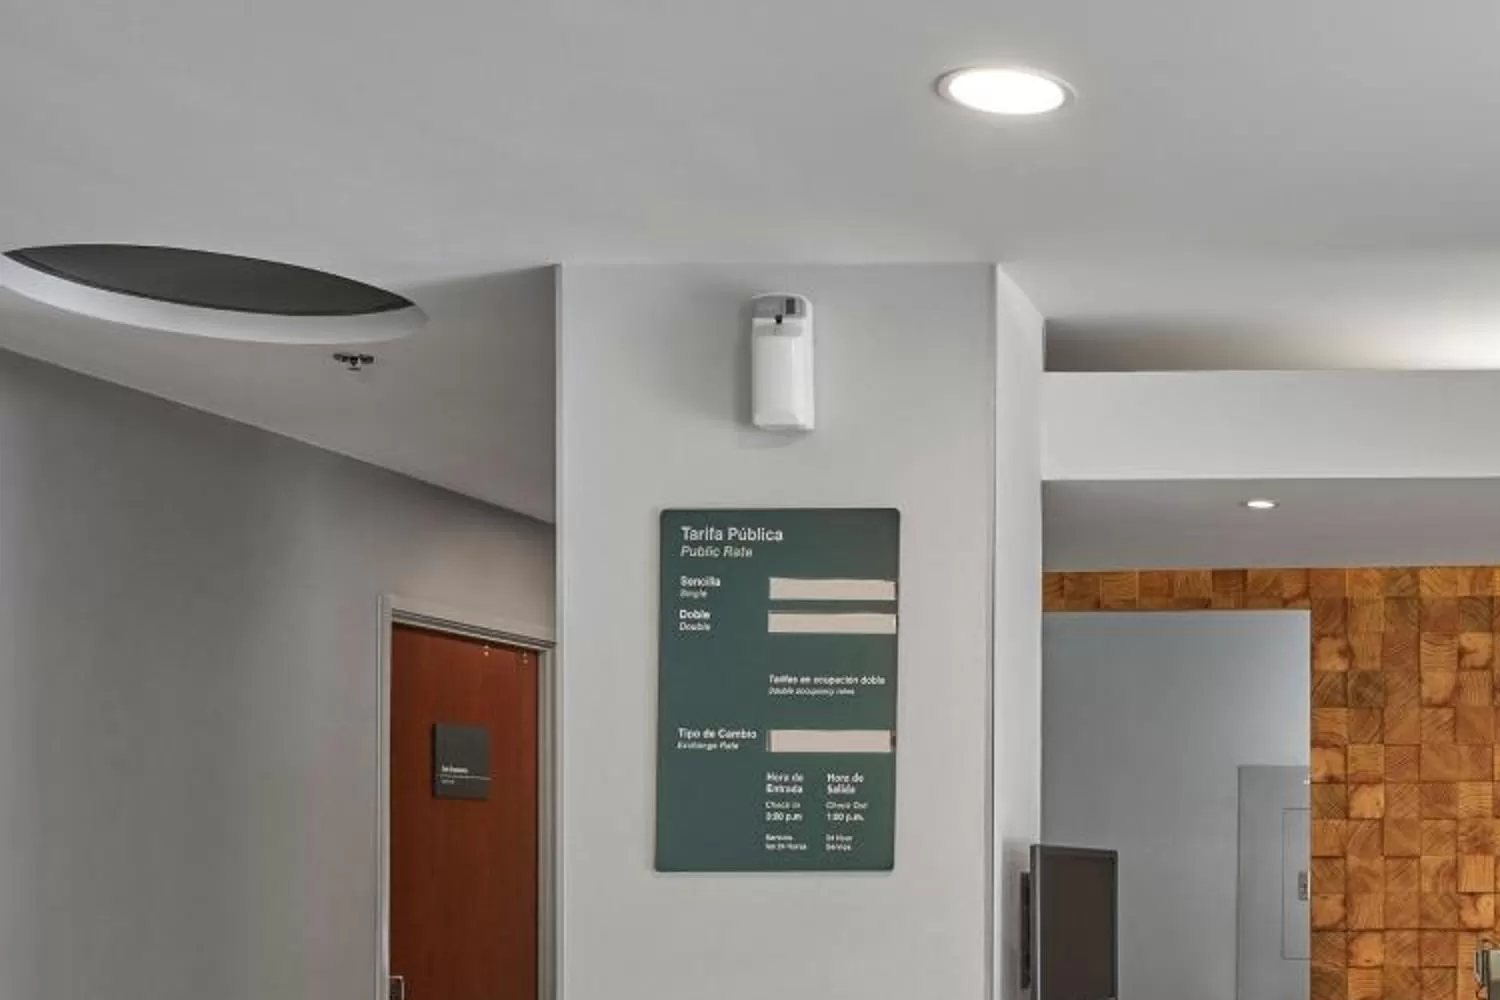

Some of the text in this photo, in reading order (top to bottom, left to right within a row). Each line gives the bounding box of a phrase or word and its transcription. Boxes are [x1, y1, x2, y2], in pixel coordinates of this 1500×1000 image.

[681, 526, 784, 541] Tarifa Pública
[680, 545, 753, 558] Public Rate
[679, 609, 711, 619] Doble
[679, 621, 711, 632] Double
[678, 727, 757, 740] Tipo de Cambio
